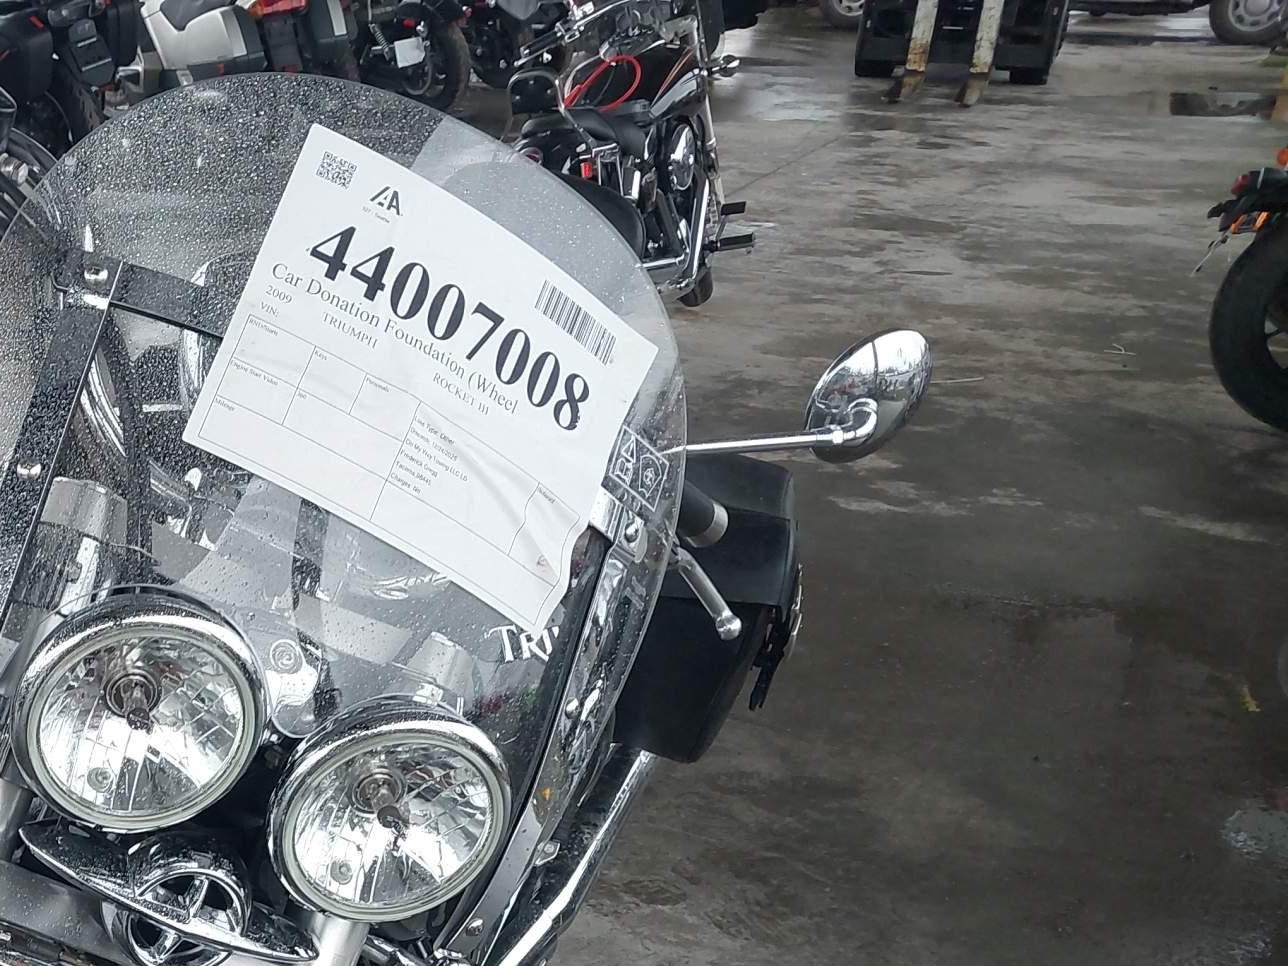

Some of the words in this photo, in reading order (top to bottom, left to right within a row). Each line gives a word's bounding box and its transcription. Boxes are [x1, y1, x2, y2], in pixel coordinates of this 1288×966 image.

[260, 301, 280, 318] VIN:
[265, 284, 293, 304] 2009
[321, 311, 379, 350] TRIUMPH
[432, 372, 476, 407] ROCKET
[477, 403, 490, 416] III
[272, 262, 304, 289] Car
[305, 278, 381, 329] Donation
[383, 317, 466, 379] Foundation
[466, 370, 520, 415] (Wheel
[309, 225, 591, 432] 44007008
